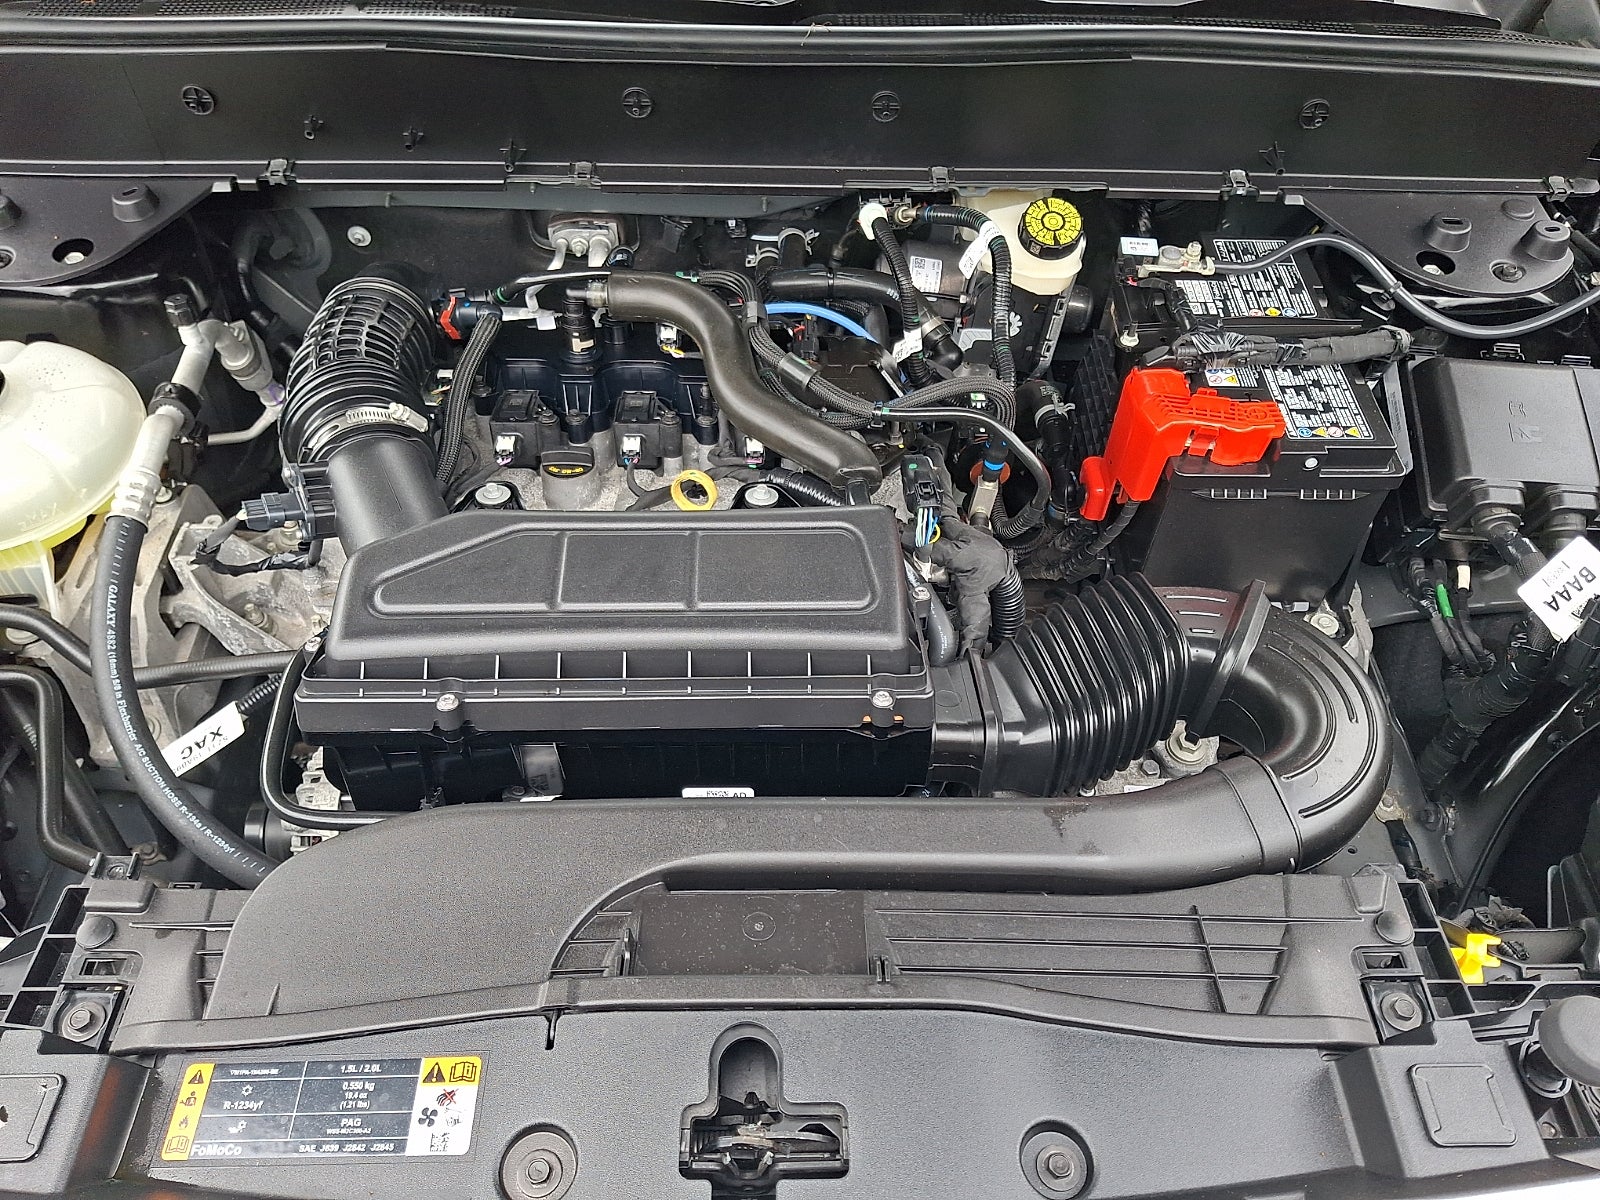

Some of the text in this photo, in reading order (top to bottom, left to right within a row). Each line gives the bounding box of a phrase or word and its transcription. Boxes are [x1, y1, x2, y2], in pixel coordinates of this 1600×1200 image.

[1543, 565, 1597, 612] BAAA
[106, 584, 119, 628] GALAXY
[116, 699, 138, 742] Flexbarrier
[134, 743, 147, 757] A/C
[141, 755, 168, 790] SUCTION
[162, 786, 182, 808] HOSE
[179, 805, 203, 829] R-134a
[204, 828, 236, 854] R-1234yf
[180, 726, 226, 761] XAC
[340, 1064, 359, 1073] 1.5L
[363, 1064, 382, 1073] 2.0L
[342, 1081, 376, 1092] 0.550 kg
[223, 1101, 264, 1111] R-1234yf
[340, 1118, 362, 1127] PAG
[190, 1144, 243, 1156] FoMoCo
[299, 1144, 317, 1153] SAE
